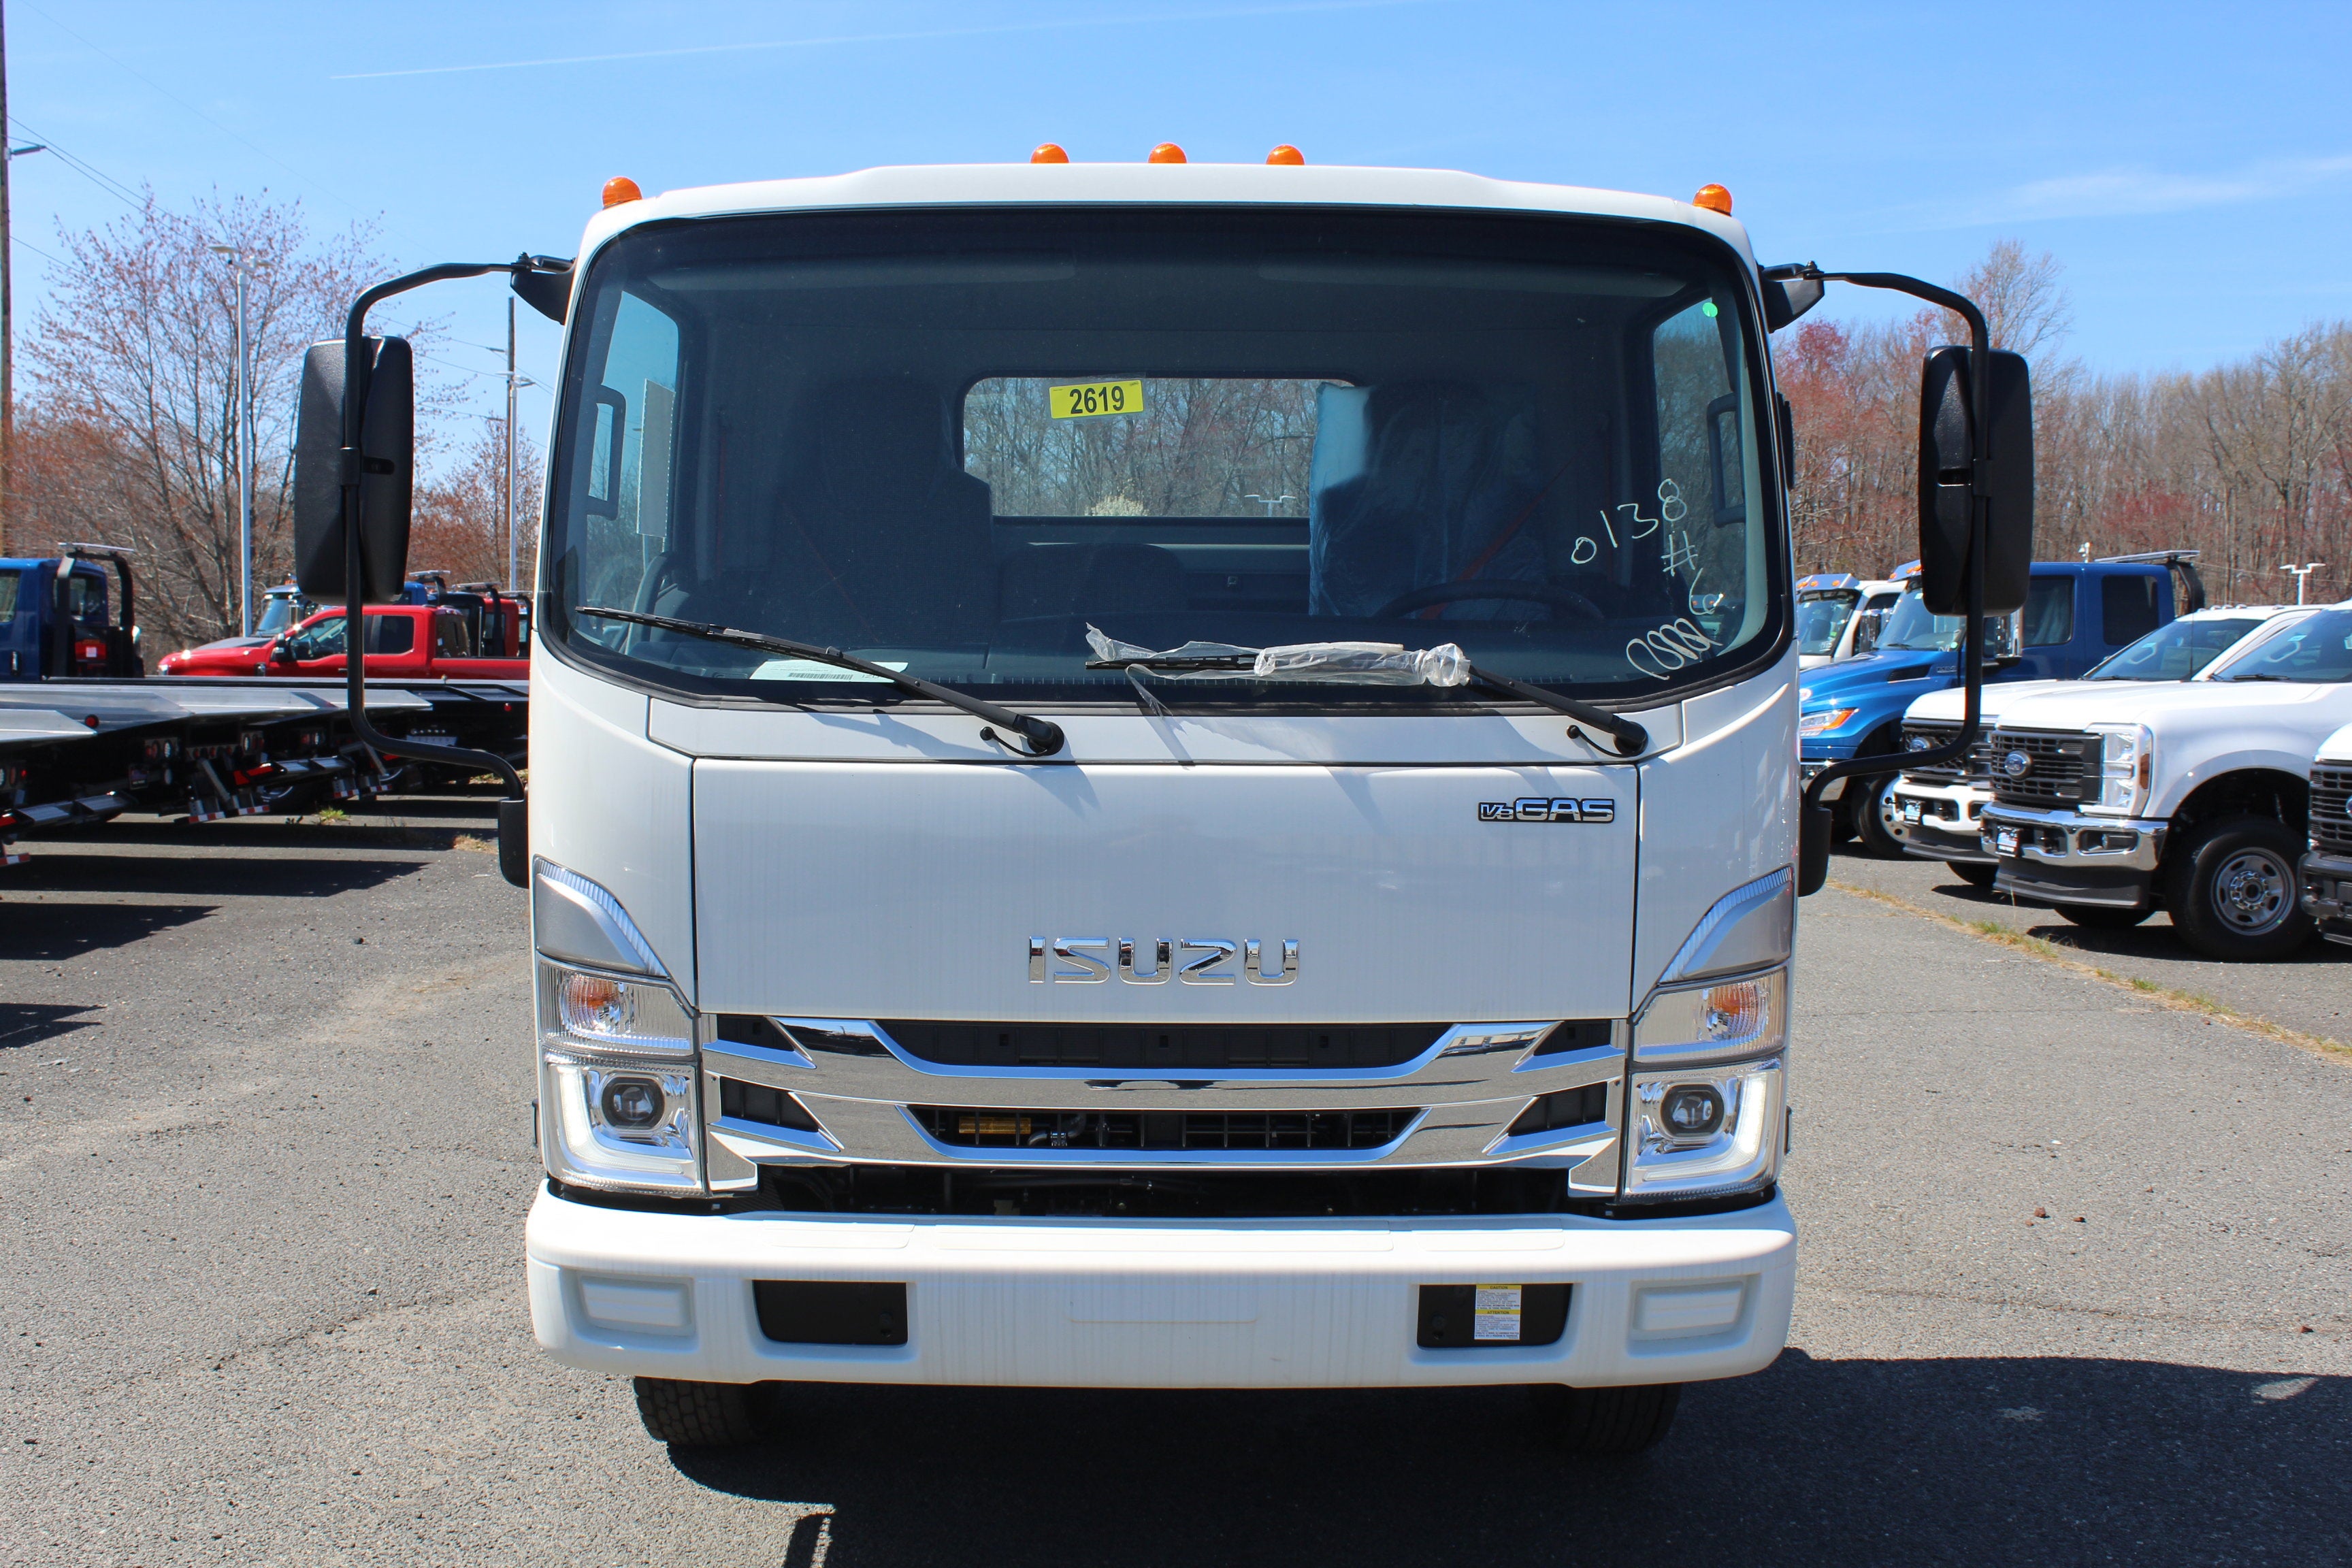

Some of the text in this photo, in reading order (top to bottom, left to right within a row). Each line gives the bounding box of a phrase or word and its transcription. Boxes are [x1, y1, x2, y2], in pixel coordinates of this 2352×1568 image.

[1070, 386, 1124, 414] 2619
[1571, 478, 1687, 564] 0138
[1515, 798, 1614, 822] GAS
[1028, 936, 1299, 986] ISUZU
